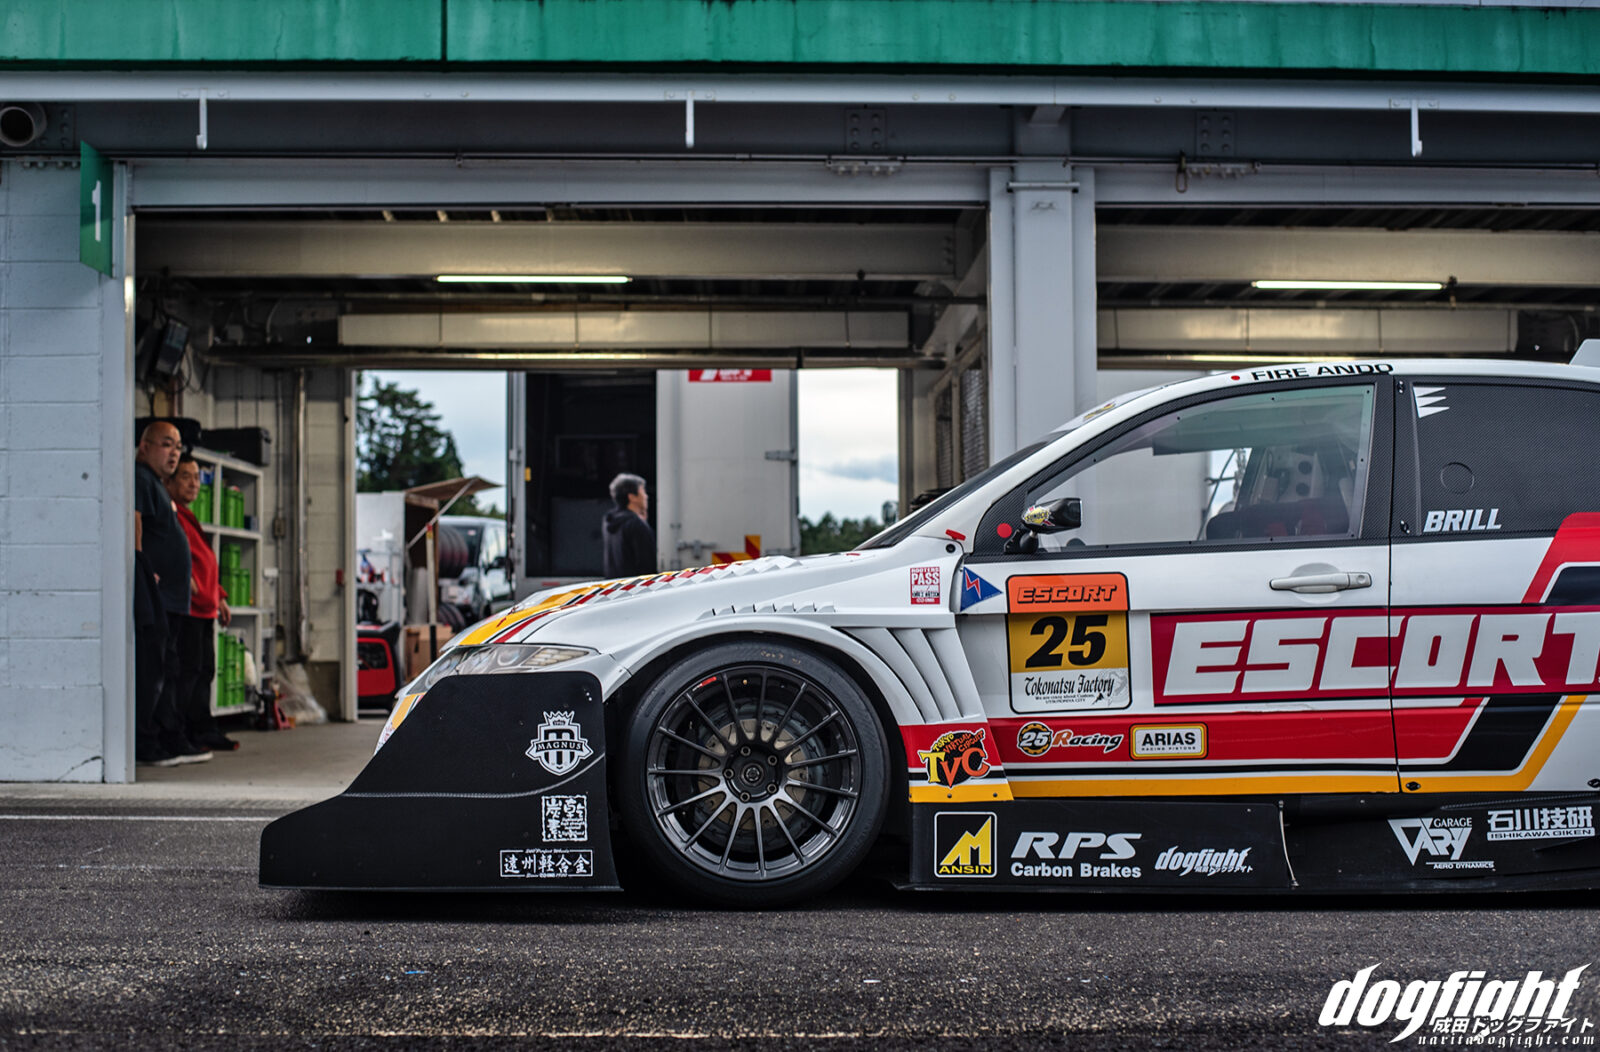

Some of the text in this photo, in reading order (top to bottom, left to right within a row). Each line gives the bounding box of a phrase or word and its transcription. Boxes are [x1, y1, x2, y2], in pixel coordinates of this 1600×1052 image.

[92, 180, 102, 242] 1
[1251, 363, 1394, 381] FIRE ANDO
[1423, 508, 1502, 533] BRILL
[911, 573, 940, 586] PASS
[1017, 584, 1117, 604] ESCORT
[1025, 614, 1108, 669] 25
[1162, 611, 1600, 697] ESCORT
[1024, 673, 1115, 697] Tokonatsu Factory
[537, 741, 582, 751] MAGNUS
[933, 733, 954, 752] TOKYO
[1019, 729, 1124, 754] 25 Racing
[1141, 731, 1197, 747] ARIAS
[919, 747, 991, 788] TVC
[1433, 817, 1473, 829] GARAGE
[1487, 806, 1593, 832] 石川技研
[1490, 829, 1592, 839] ISHIKAWA GIKEN
[1010, 831, 1142, 861] RPS
[503, 853, 590, 874] 遠州軽合金
[938, 864, 992, 875] ANSIN
[1010, 861, 1142, 879] Carbon Brakes
[1154, 845, 1252, 877] dogfight
[1455, 862, 1496, 870] DYNAMICS
